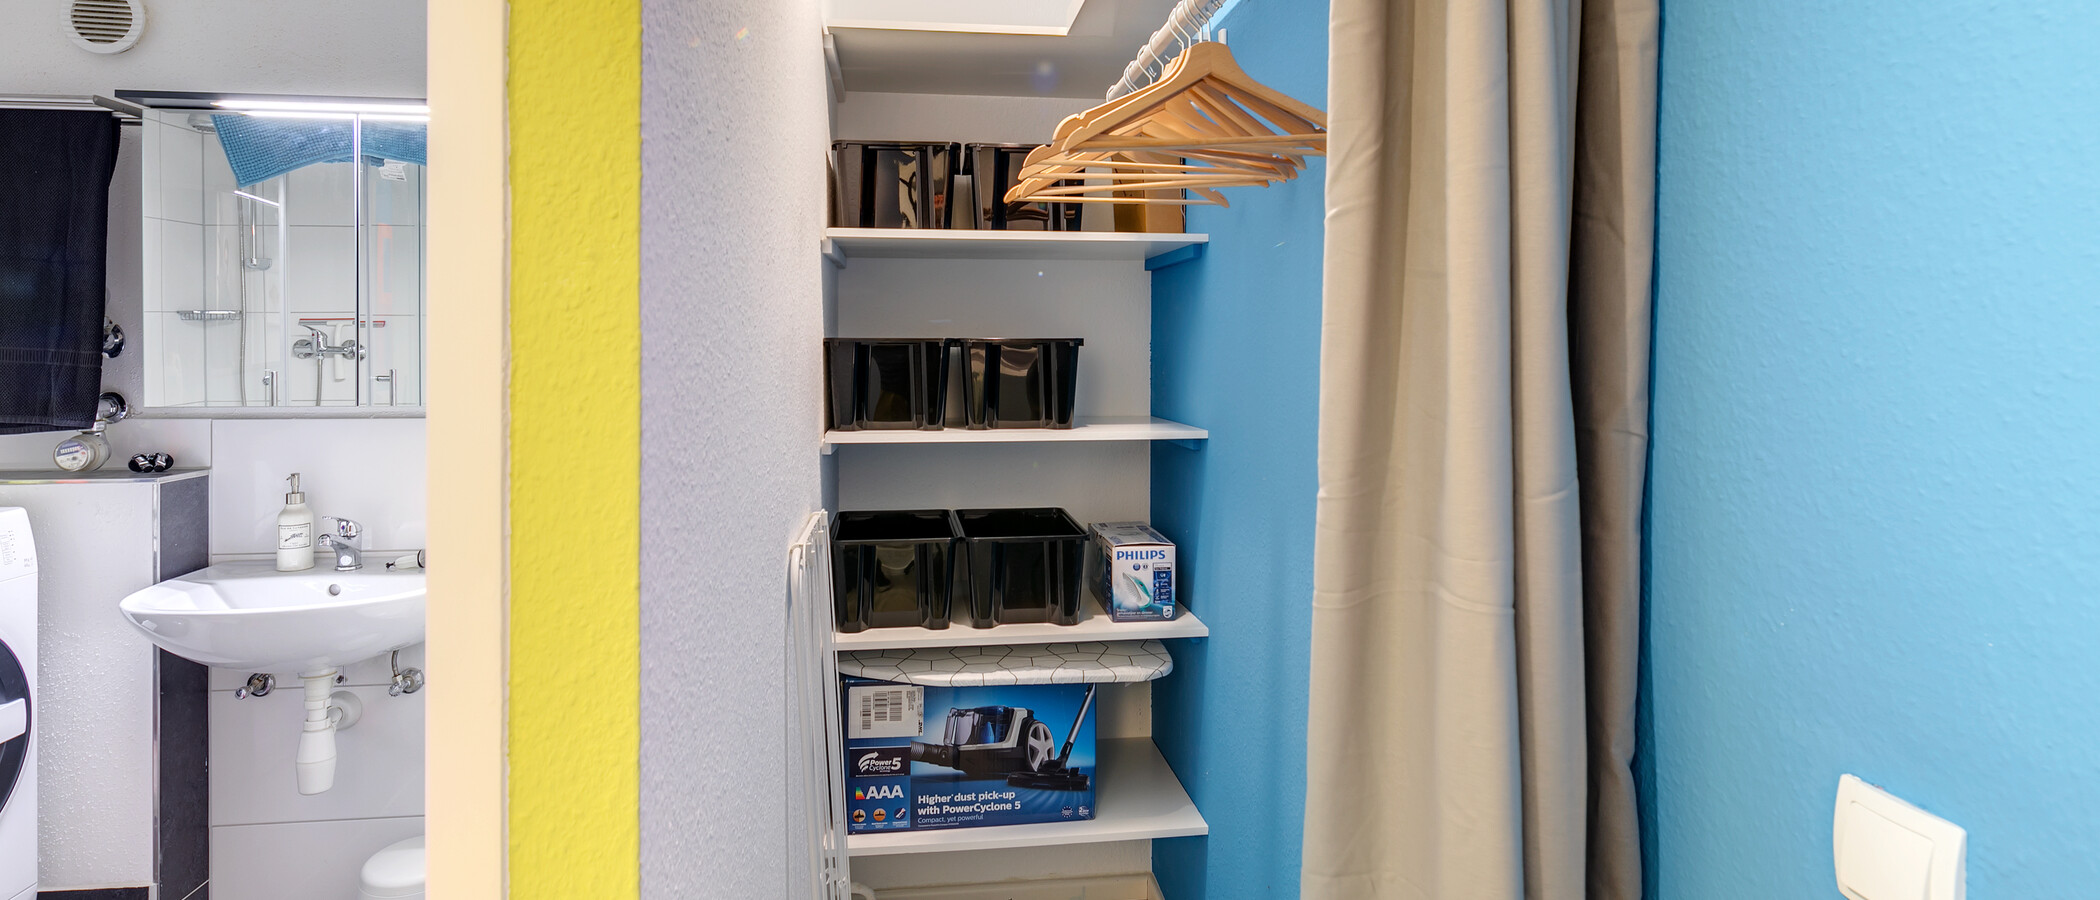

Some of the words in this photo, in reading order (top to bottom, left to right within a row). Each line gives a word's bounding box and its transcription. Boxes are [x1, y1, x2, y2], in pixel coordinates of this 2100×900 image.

[1116, 550, 1166, 560] PHILIPS
[891, 757, 902, 771] 5
[866, 785, 904, 799] AAA
[954, 792, 976, 802] dust
[978, 791, 1016, 802] pick-up
[917, 805, 940, 815] with
[942, 802, 1012, 813] PowerCyclone
[1014, 801, 1021, 810] 5
[917, 816, 946, 824] Compact,
[947, 815, 957, 823] yet
[958, 814, 984, 822] powerful
